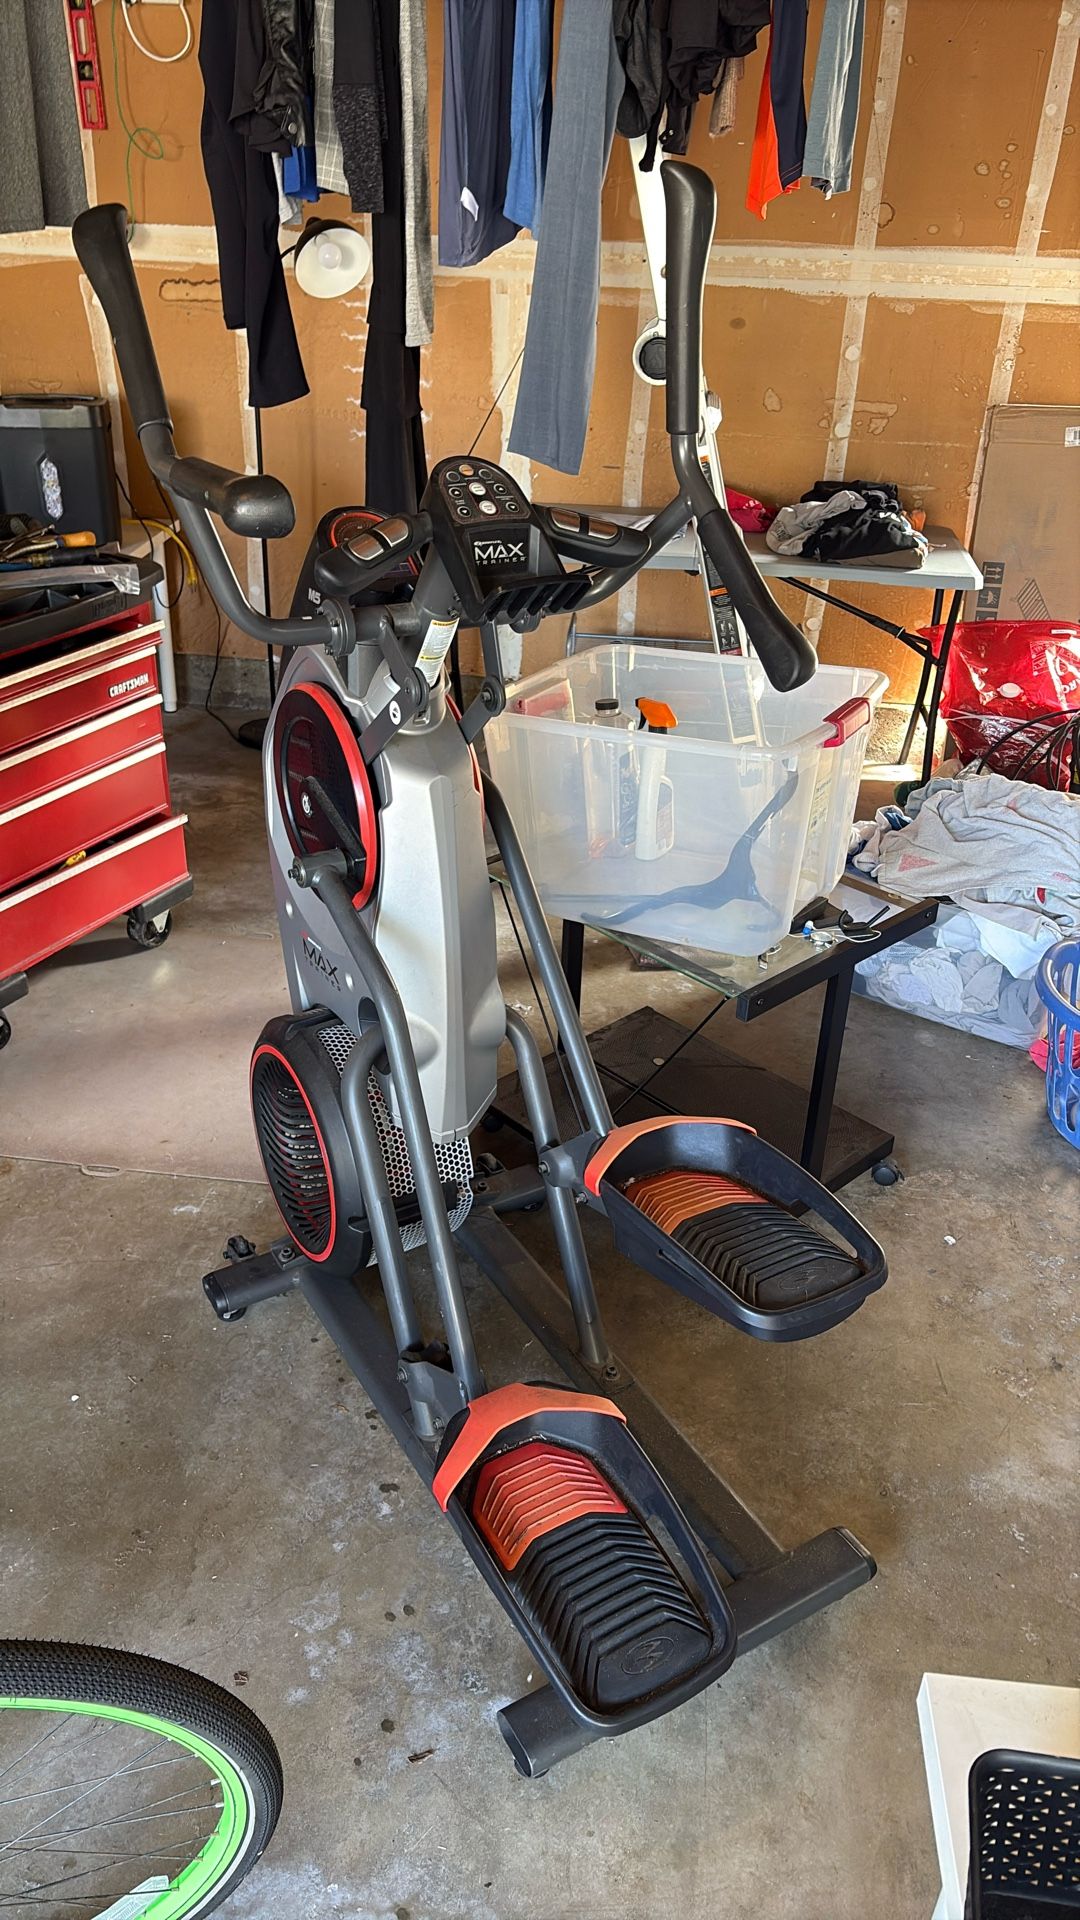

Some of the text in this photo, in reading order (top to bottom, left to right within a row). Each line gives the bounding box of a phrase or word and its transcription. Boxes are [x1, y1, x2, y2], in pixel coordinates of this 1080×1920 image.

[474, 542, 524, 560] MAX
[475, 556, 527, 566] TRAINER
[308, 587, 321, 605] M5
[110, 673, 149, 698] CRAFTSMAN
[303, 938, 340, 985] MAX
